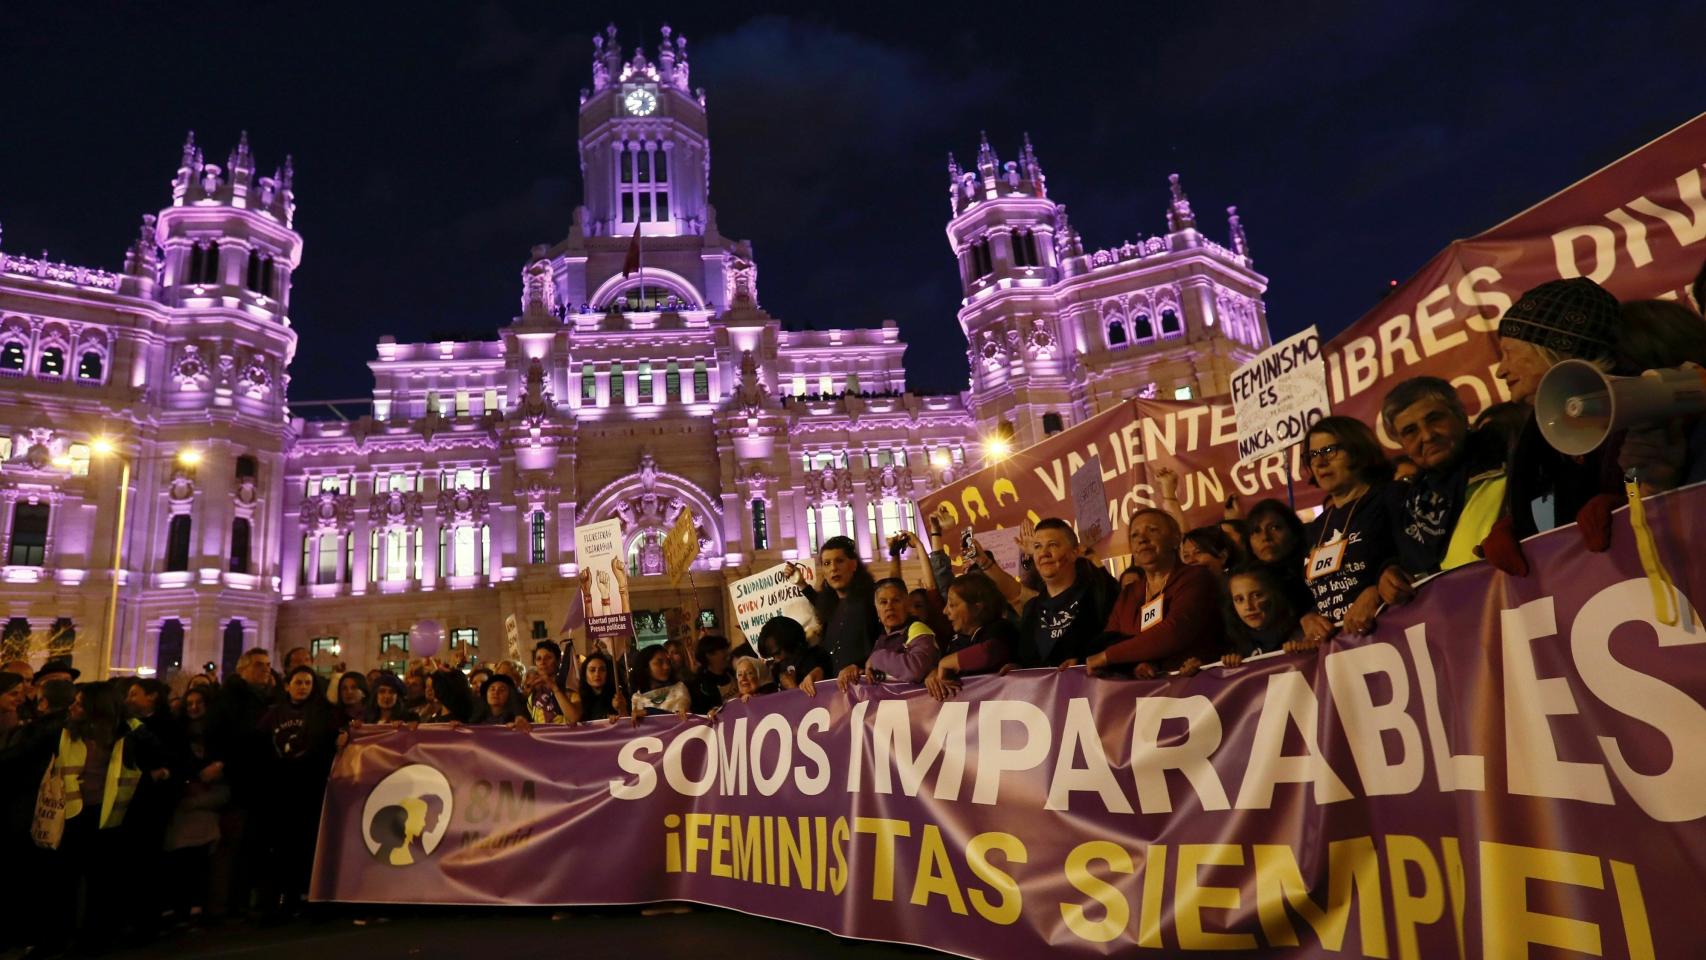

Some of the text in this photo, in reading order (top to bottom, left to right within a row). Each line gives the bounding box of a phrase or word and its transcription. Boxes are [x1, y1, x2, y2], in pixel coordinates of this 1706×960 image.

[1551, 164, 1706, 285] DIV
[1232, 335, 1320, 402] FEMINISMO
[1259, 386, 1278, 408] ES
[1239, 429, 1274, 458] NUNCA
[1276, 407, 1324, 441] ODIO
[1315, 557, 1332, 571] DR
[767, 592, 777, 606] LAS
[777, 585, 803, 602] MUJERE
[588, 617, 607, 625] Libertad
[608, 617, 618, 625] para
[1144, 608, 1156, 622] DR
[590, 625, 606, 633] Presas
[609, 577, 1706, 823] SOMOS IMPARABLES
[464, 779, 536, 824] 8M
